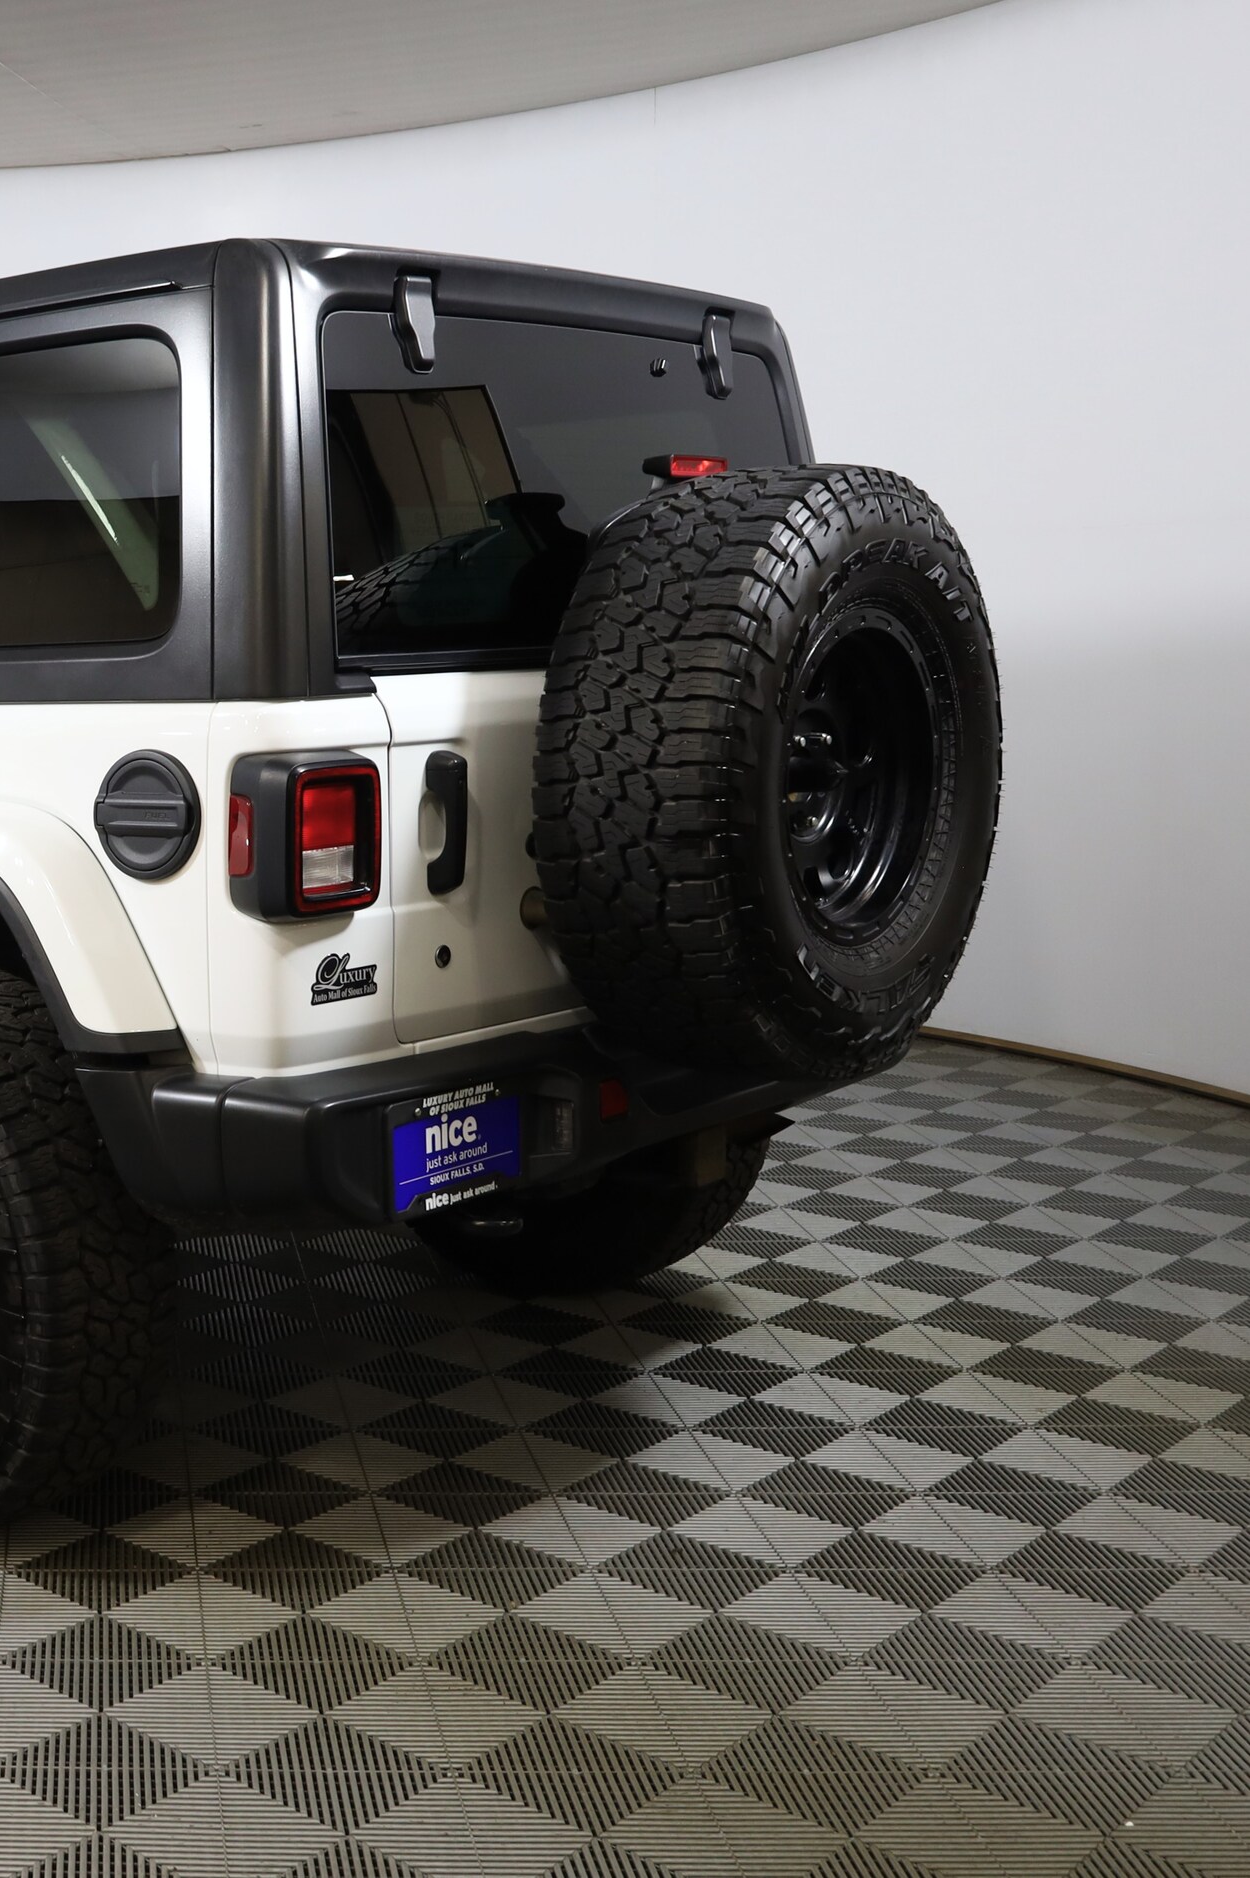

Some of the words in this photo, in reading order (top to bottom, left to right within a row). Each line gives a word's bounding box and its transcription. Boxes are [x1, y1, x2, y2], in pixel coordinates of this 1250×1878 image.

[313, 955, 376, 990] Luxury
[314, 993, 328, 1003] Auto
[328, 990, 340, 1000] Mall
[341, 988, 348, 997] of
[348, 987, 363, 996] Sioux
[363, 983, 376, 994] Falls
[423, 1092, 453, 1108] LUXURY
[454, 1087, 474, 1100] AUTO
[475, 1082, 494, 1095] MALL
[429, 1105, 440, 1116] OF
[441, 1099, 465, 1113] SIOUX
[466, 1094, 486, 1107] FALLS
[425, 1113, 477, 1154] nice
[426, 1155, 442, 1173] just
[443, 1151, 458, 1165] ask
[459, 1142, 488, 1160] around
[430, 1172, 449, 1185] SIOUX
[473, 1162, 485, 1172] S.D.
[425, 1192, 450, 1211] nice
[450, 1191, 462, 1205] just
[463, 1188, 474, 1199] ask
